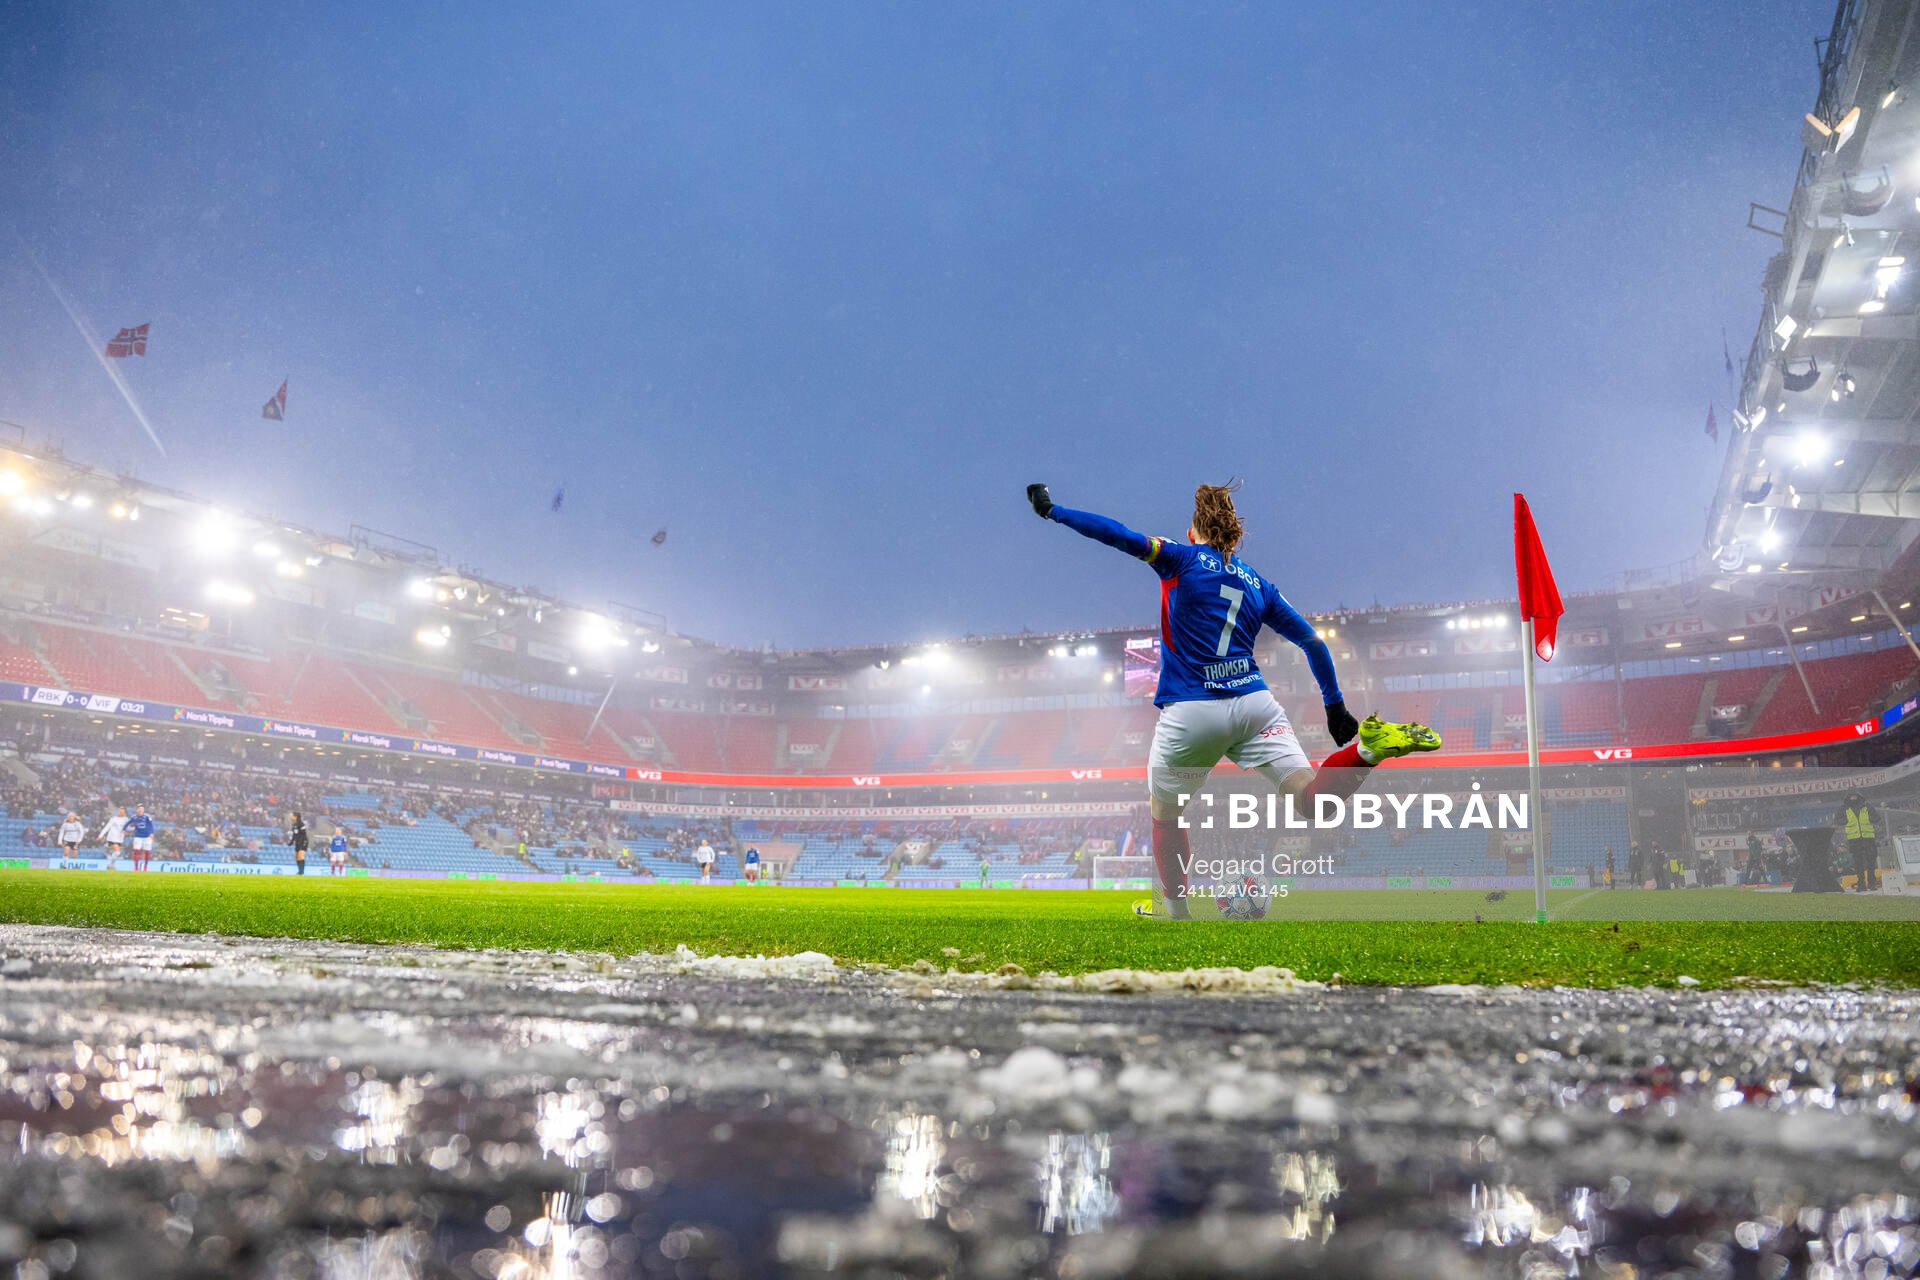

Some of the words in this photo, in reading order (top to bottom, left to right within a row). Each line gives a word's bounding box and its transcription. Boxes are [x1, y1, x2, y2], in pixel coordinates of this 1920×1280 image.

[1225, 563, 1261, 590] OBOS
[1216, 584, 1244, 657] 7
[1203, 658, 1249, 681] THOMSEN
[38, 691, 61, 701] RBK
[94, 700, 111, 708] VIF
[120, 702, 145, 713] 03:21
[186, 711, 207, 722] Norsk
[208, 714, 234, 727] Tipping
[274, 723, 293, 733] Norsk
[294, 726, 316, 738] Tipping
[1855, 721, 1873, 736] VG
[1593, 749, 1632, 759] VG
[637, 770, 662, 781] VG
[853, 777, 880, 785] VG
[1071, 770, 1102, 779] VG
